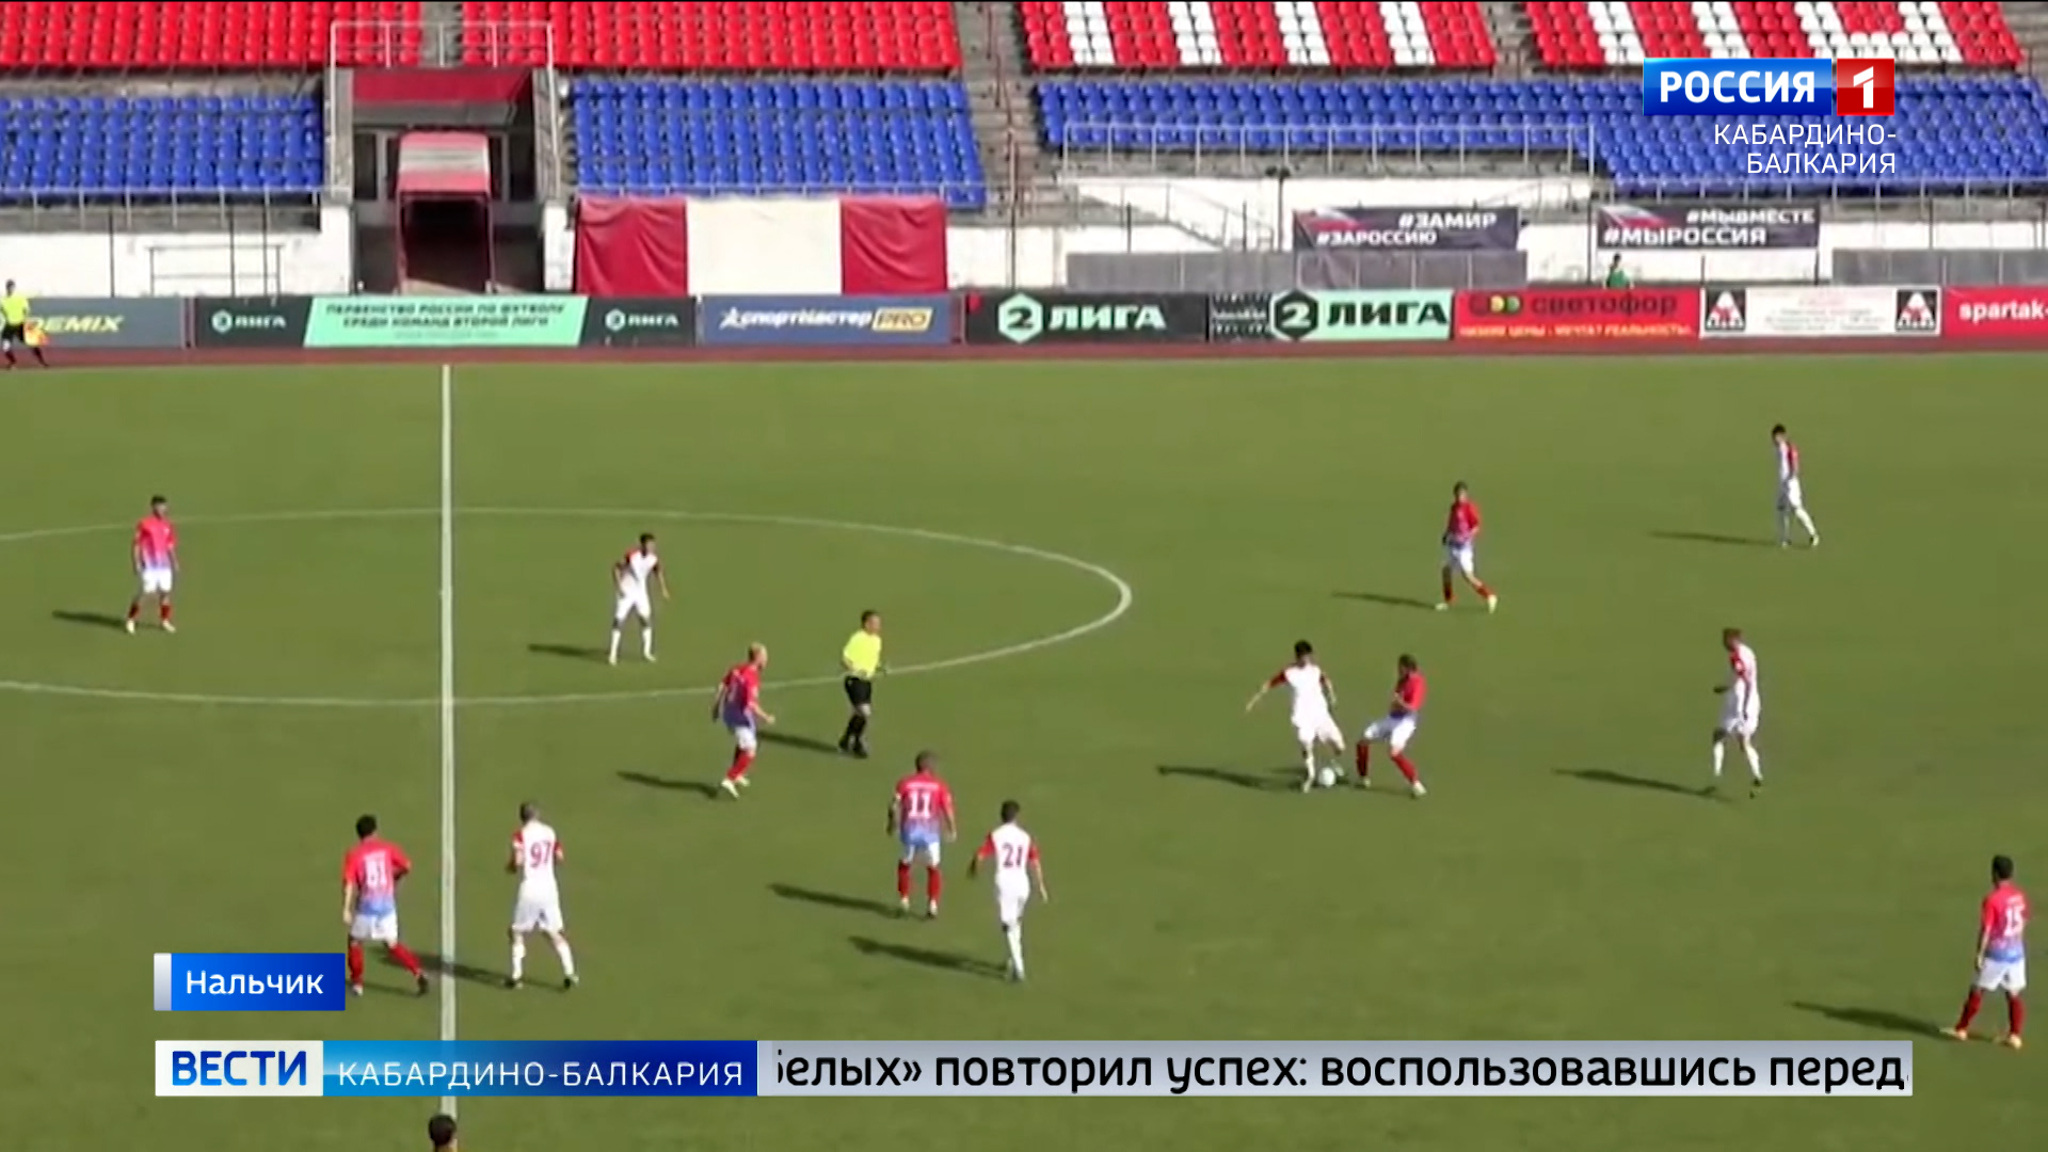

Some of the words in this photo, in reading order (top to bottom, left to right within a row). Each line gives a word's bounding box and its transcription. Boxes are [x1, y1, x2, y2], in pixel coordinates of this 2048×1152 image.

[1398, 211, 1498, 230] #ЗАМИР
[1686, 208, 1815, 225] #МЫВМЕСТЕ
[1315, 230, 1438, 246] #ЗАРОССИЮ
[1603, 226, 1767, 246] #МЫРОССИЯ
[1006, 306, 1035, 331] 2
[1048, 304, 1168, 331] ЛИГА
[1281, 302, 1311, 328] 2
[1328, 301, 1448, 327] ЛИГА
[909, 791, 932, 819] 11
[530, 841, 551, 868] 97
[1003, 842, 1023, 868] 21
